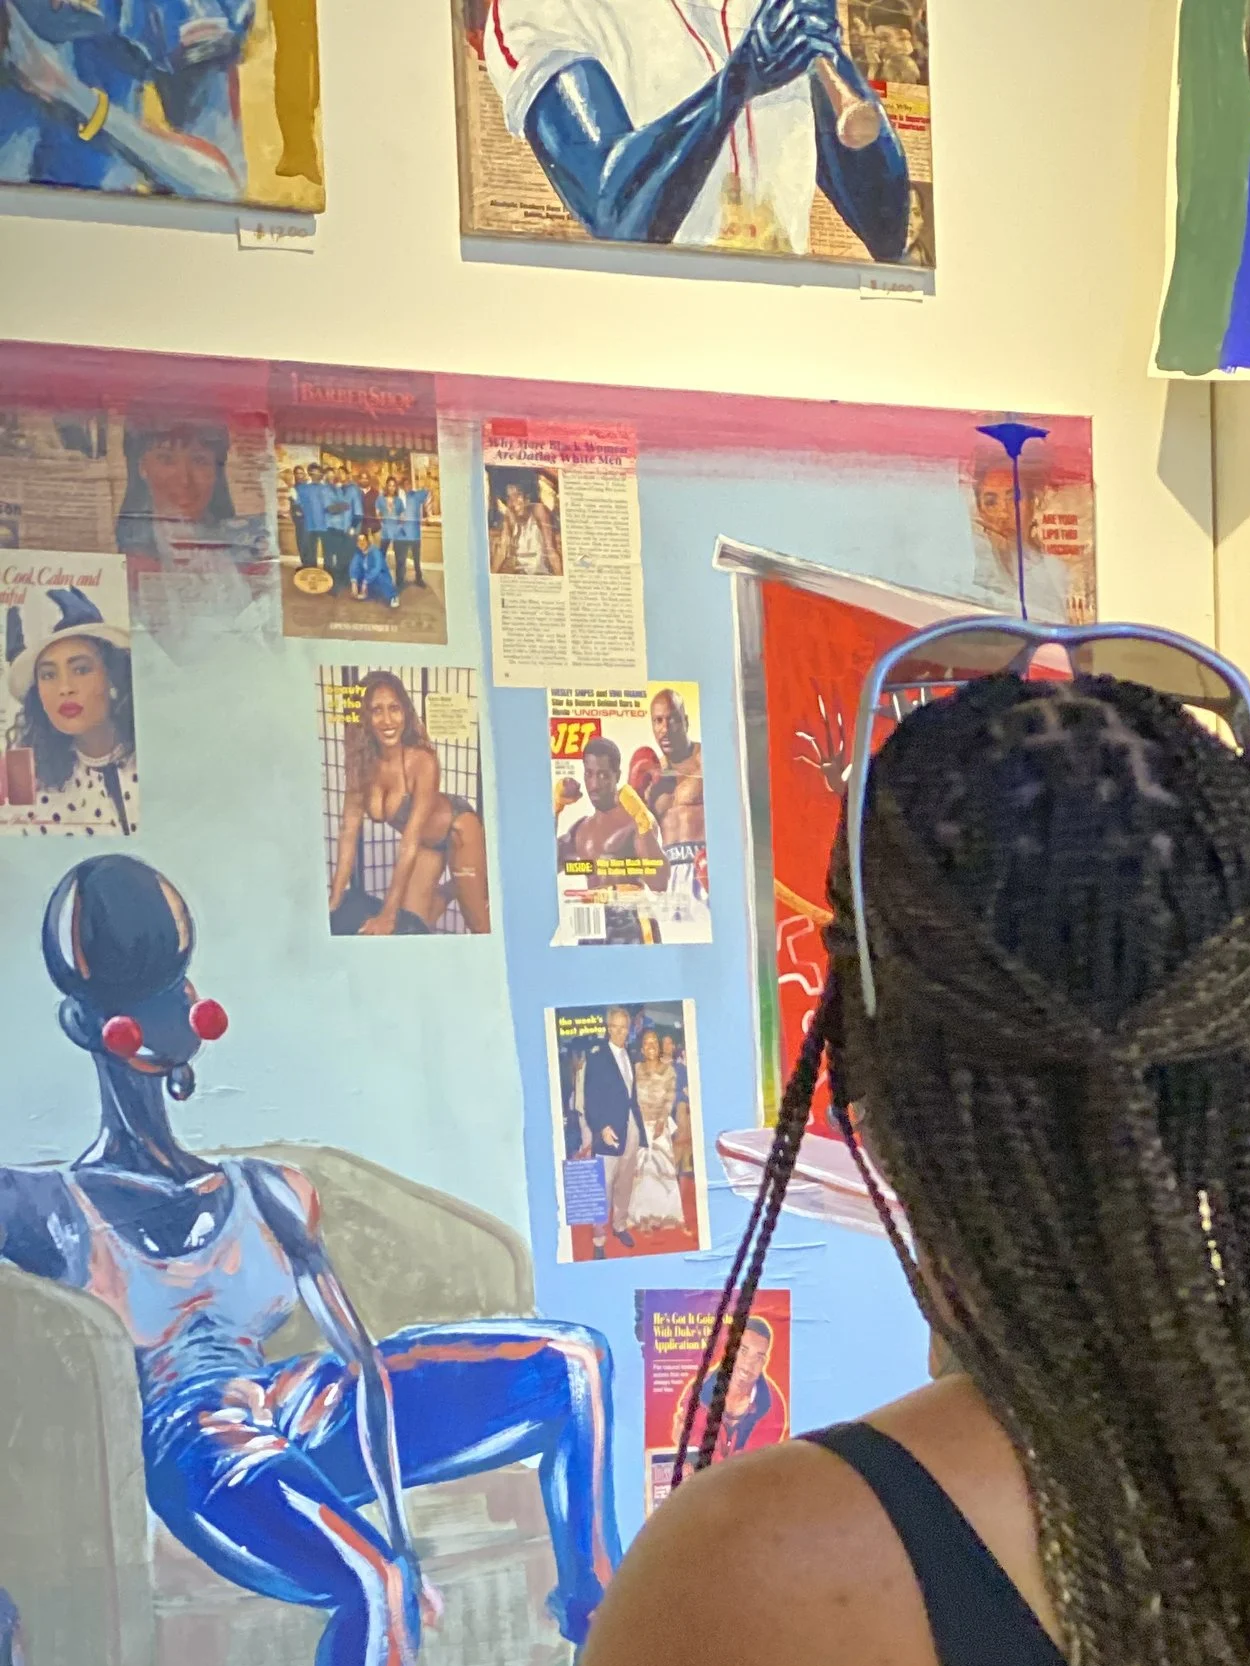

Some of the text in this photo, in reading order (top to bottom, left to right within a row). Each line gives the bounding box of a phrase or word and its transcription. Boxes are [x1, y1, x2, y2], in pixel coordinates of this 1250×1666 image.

[517, 451, 557, 463] Dating
[560, 453, 597, 464] White
[600, 455, 622, 465] Men
[38, 566, 74, 586] Calm
[343, 700, 362, 708] the
[551, 722, 596, 755] JET
[559, 1015, 603, 1026] the week's
[560, 1026, 606, 1037] best photos
[653, 1312, 670, 1325] He's
[672, 1312, 686, 1325] Got
[688, 1312, 695, 1325] It
[653, 1325, 672, 1338] With
[674, 1325, 702, 1338] Duke's
[654, 1338, 699, 1354] Application
